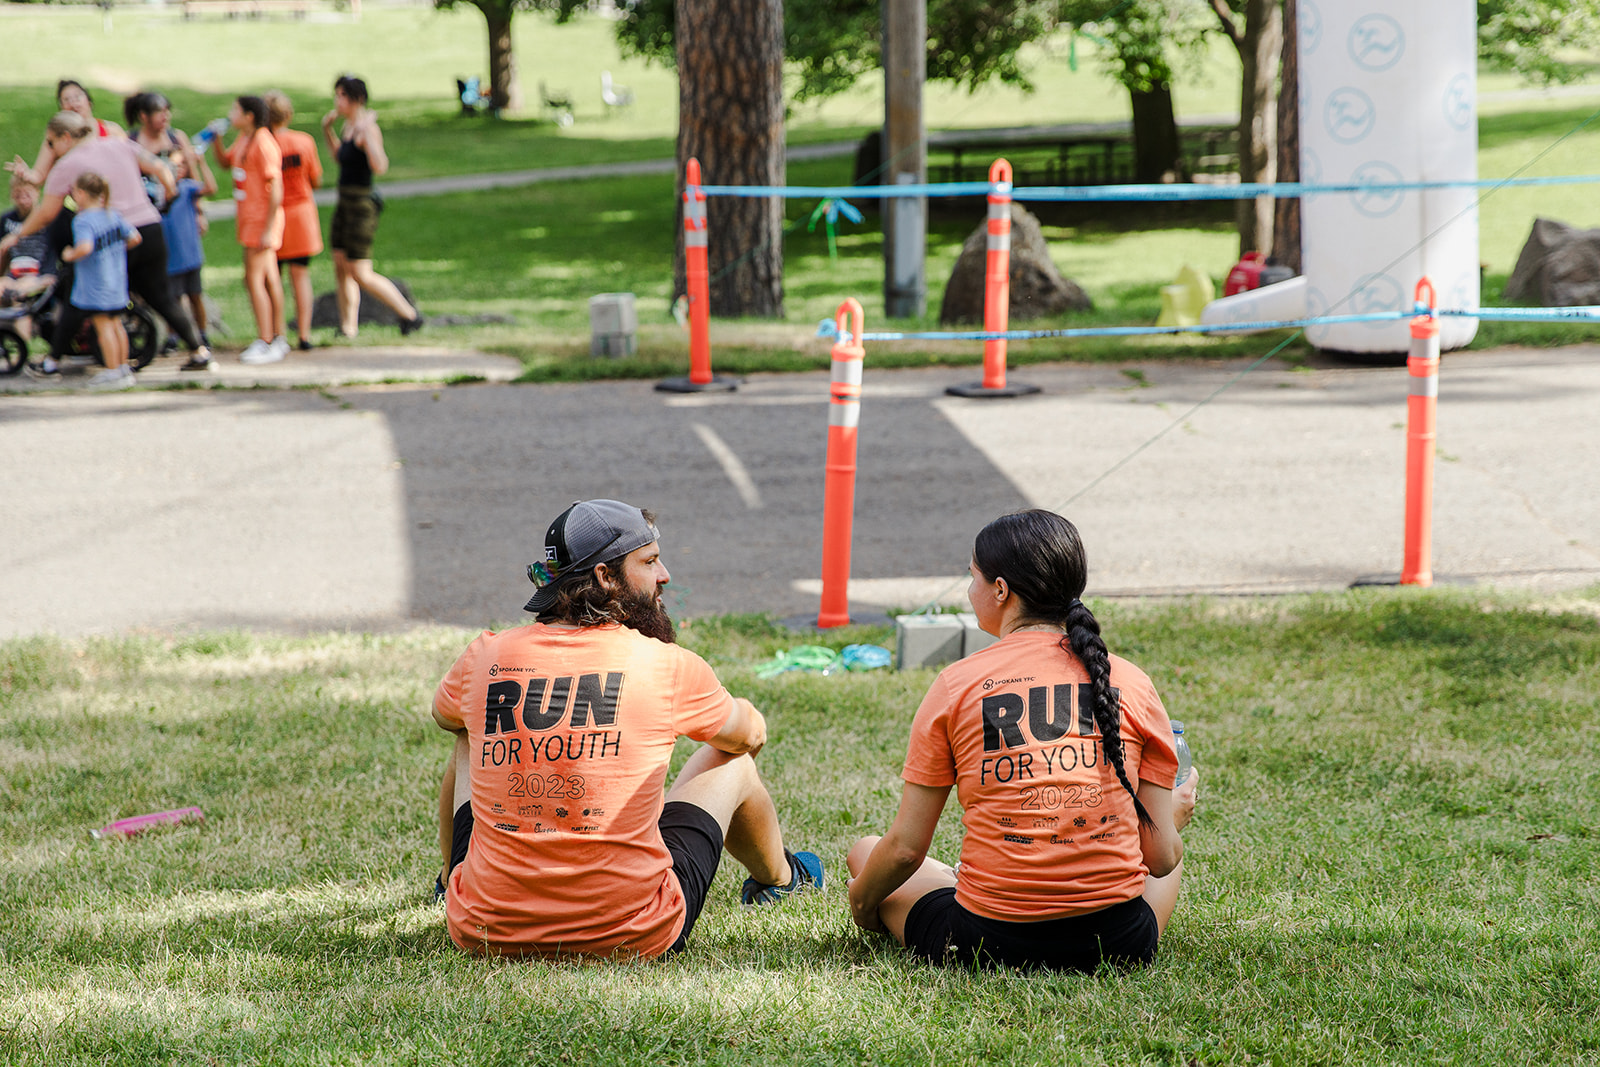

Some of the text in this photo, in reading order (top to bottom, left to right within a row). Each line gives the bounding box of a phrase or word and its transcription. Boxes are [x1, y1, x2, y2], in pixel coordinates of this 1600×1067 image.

[485, 672, 625, 737] RUN
[482, 731, 622, 768] FOR YOUTH
[507, 772, 586, 800] 2023
[981, 752, 1034, 786] FOR
[1019, 783, 1103, 811] 2023
